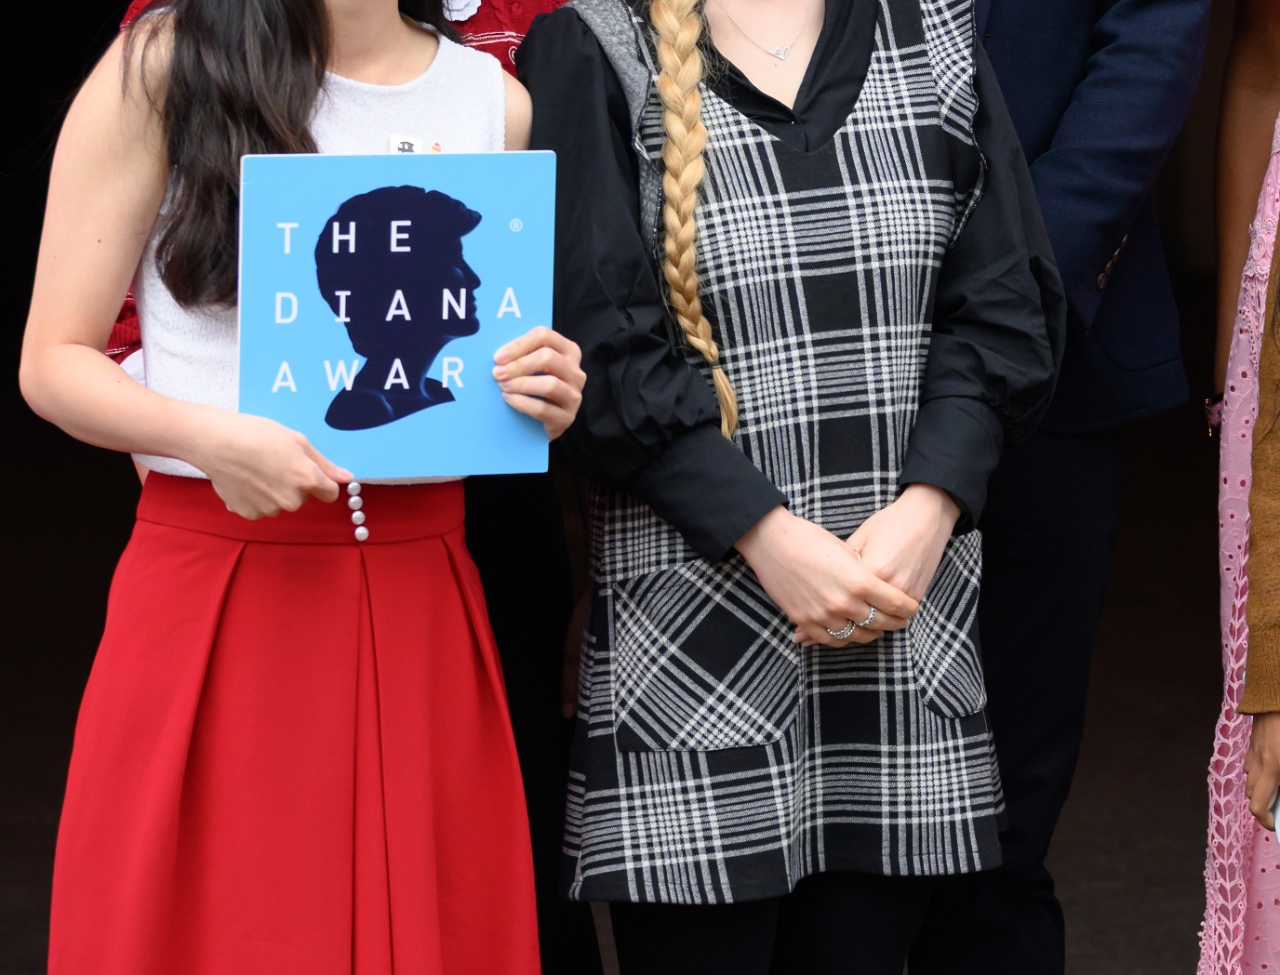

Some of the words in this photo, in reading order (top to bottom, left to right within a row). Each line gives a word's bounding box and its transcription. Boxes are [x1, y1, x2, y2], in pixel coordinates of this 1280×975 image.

[276, 220, 412, 254] THE
[275, 287, 522, 324] DIANA
[271, 357, 464, 393] AWAR
